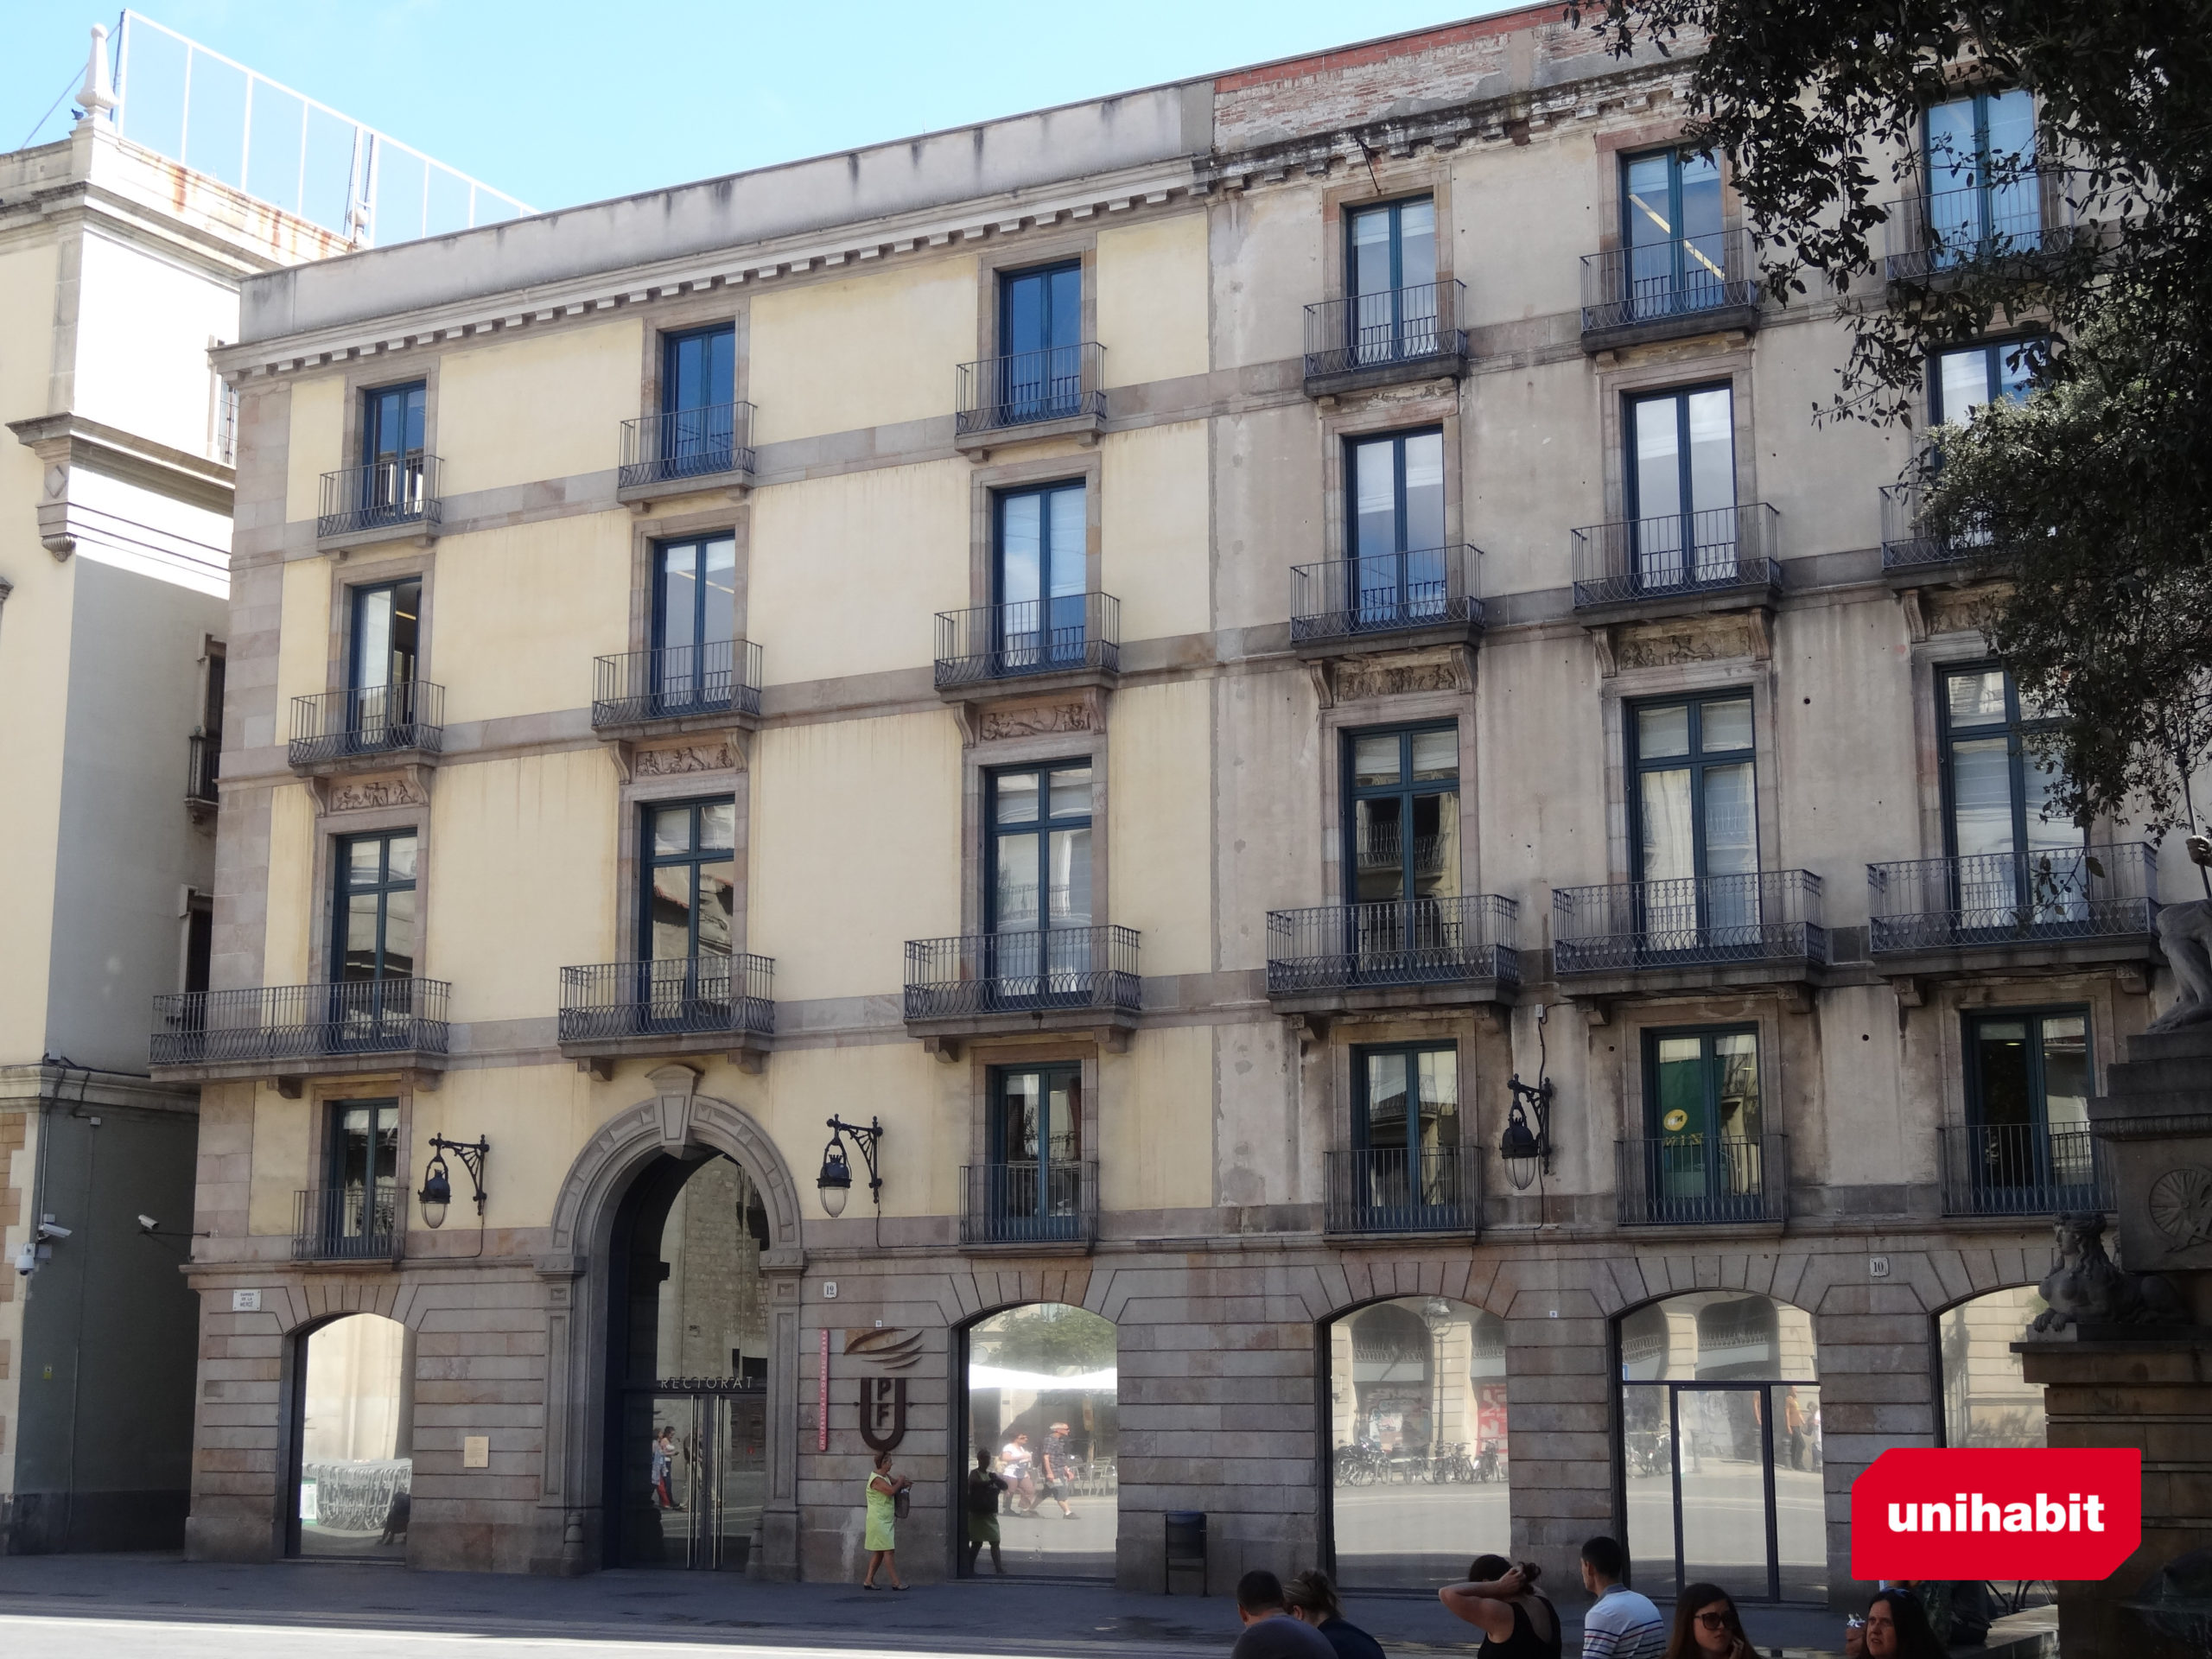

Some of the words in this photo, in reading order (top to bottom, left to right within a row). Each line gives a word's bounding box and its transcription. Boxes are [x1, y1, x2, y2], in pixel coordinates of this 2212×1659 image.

[1873, 1262, 1885, 1273] 10
[826, 1285, 835, 1295] 12
[661, 1376, 753, 1389] RECTORAT
